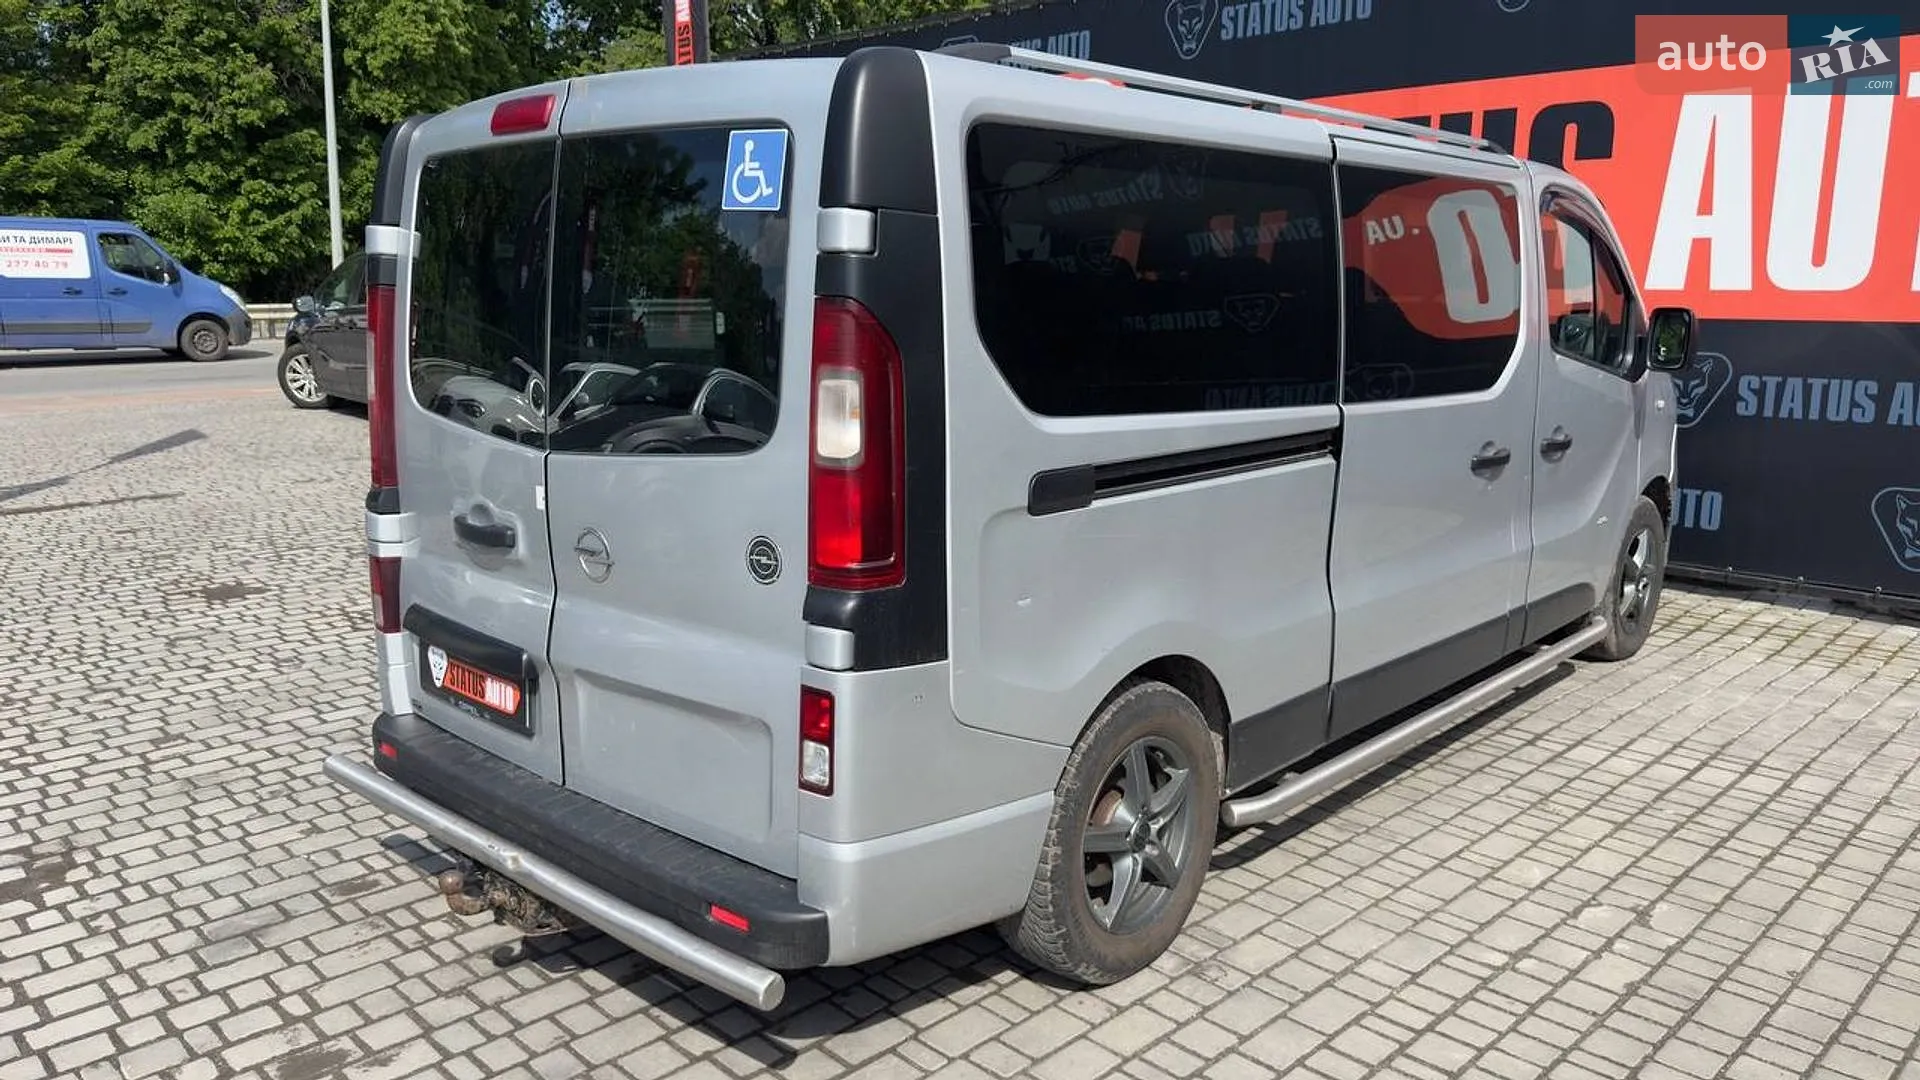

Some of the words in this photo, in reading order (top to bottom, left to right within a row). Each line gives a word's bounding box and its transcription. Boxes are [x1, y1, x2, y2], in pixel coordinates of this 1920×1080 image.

[1220, 0, 1304, 41] STATUS
[1643, 71, 1920, 292] AU
[1735, 375, 1879, 424] STATUS
[449, 661, 486, 699] STATUS
[484, 676, 515, 712] AUTO
